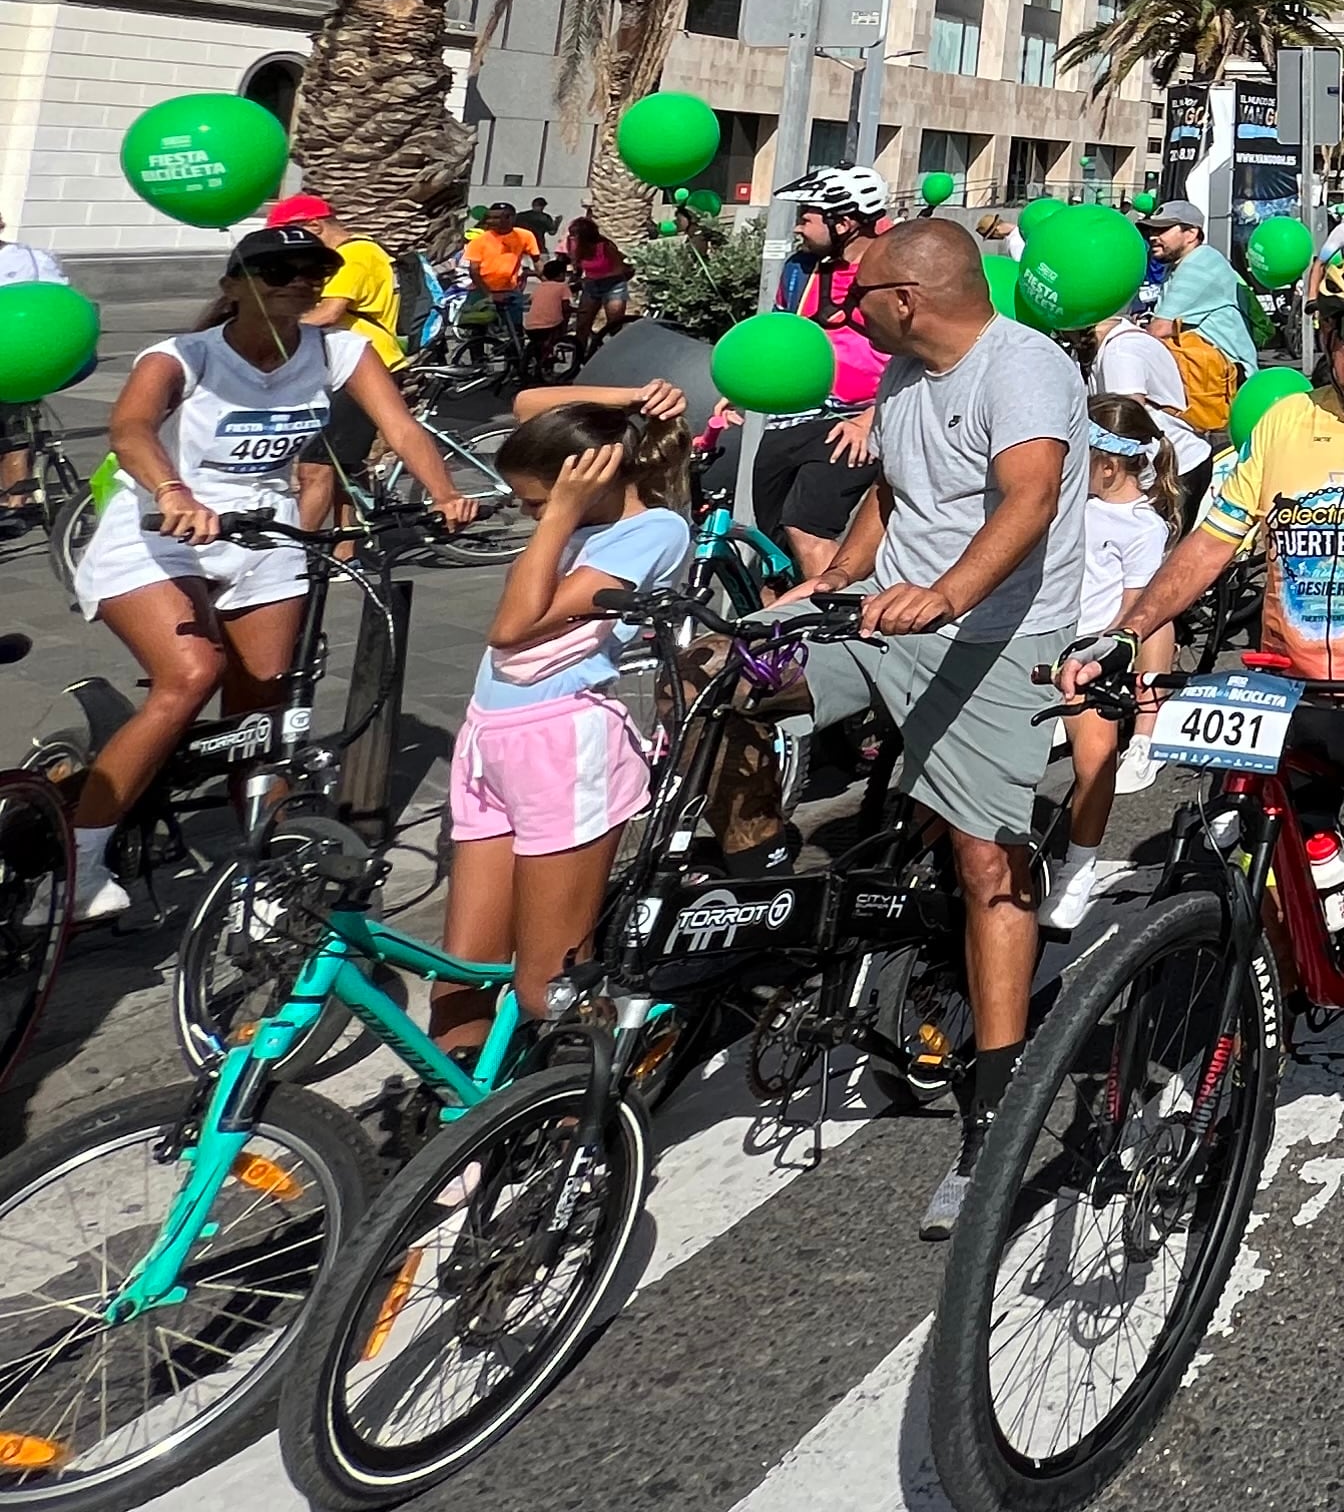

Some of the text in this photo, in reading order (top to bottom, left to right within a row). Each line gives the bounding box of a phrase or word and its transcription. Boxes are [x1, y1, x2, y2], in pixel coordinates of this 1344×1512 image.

[1179, 686, 1219, 699] FIESTA
[1228, 688, 1288, 708] BICICLETA
[1180, 707, 1264, 749] 4031
[679, 904, 769, 928] TORROT
[1251, 956, 1277, 1049] MAXXIS
